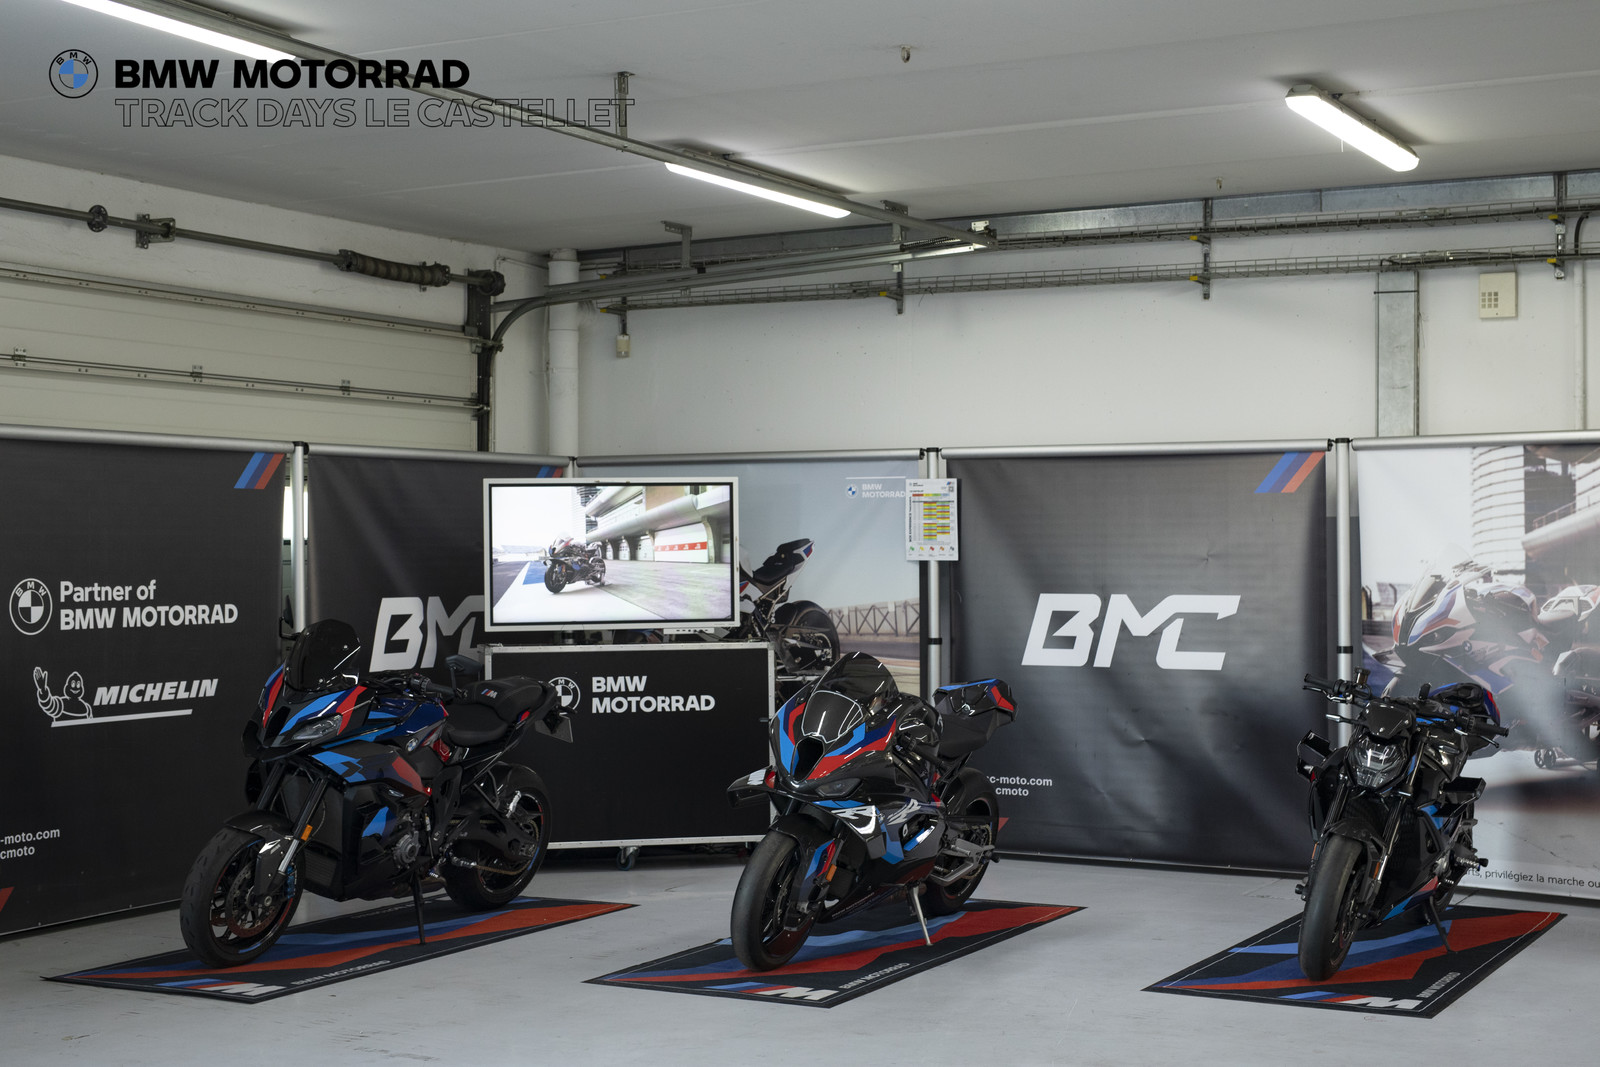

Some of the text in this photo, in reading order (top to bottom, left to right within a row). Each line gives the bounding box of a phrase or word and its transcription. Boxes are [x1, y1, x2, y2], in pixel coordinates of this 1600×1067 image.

[60, 579, 157, 602] Partner of
[60, 604, 239, 630] BMW MOTORRAD
[1021, 593, 1241, 671] BMC
[93, 679, 218, 706] MICHELIN
[592, 676, 647, 693] BMW
[592, 695, 716, 713] MOTORRAD
[1485, 870, 1534, 882] privilégiez
[1537, 873, 1545, 883] la
[1548, 875, 1585, 886] marche
